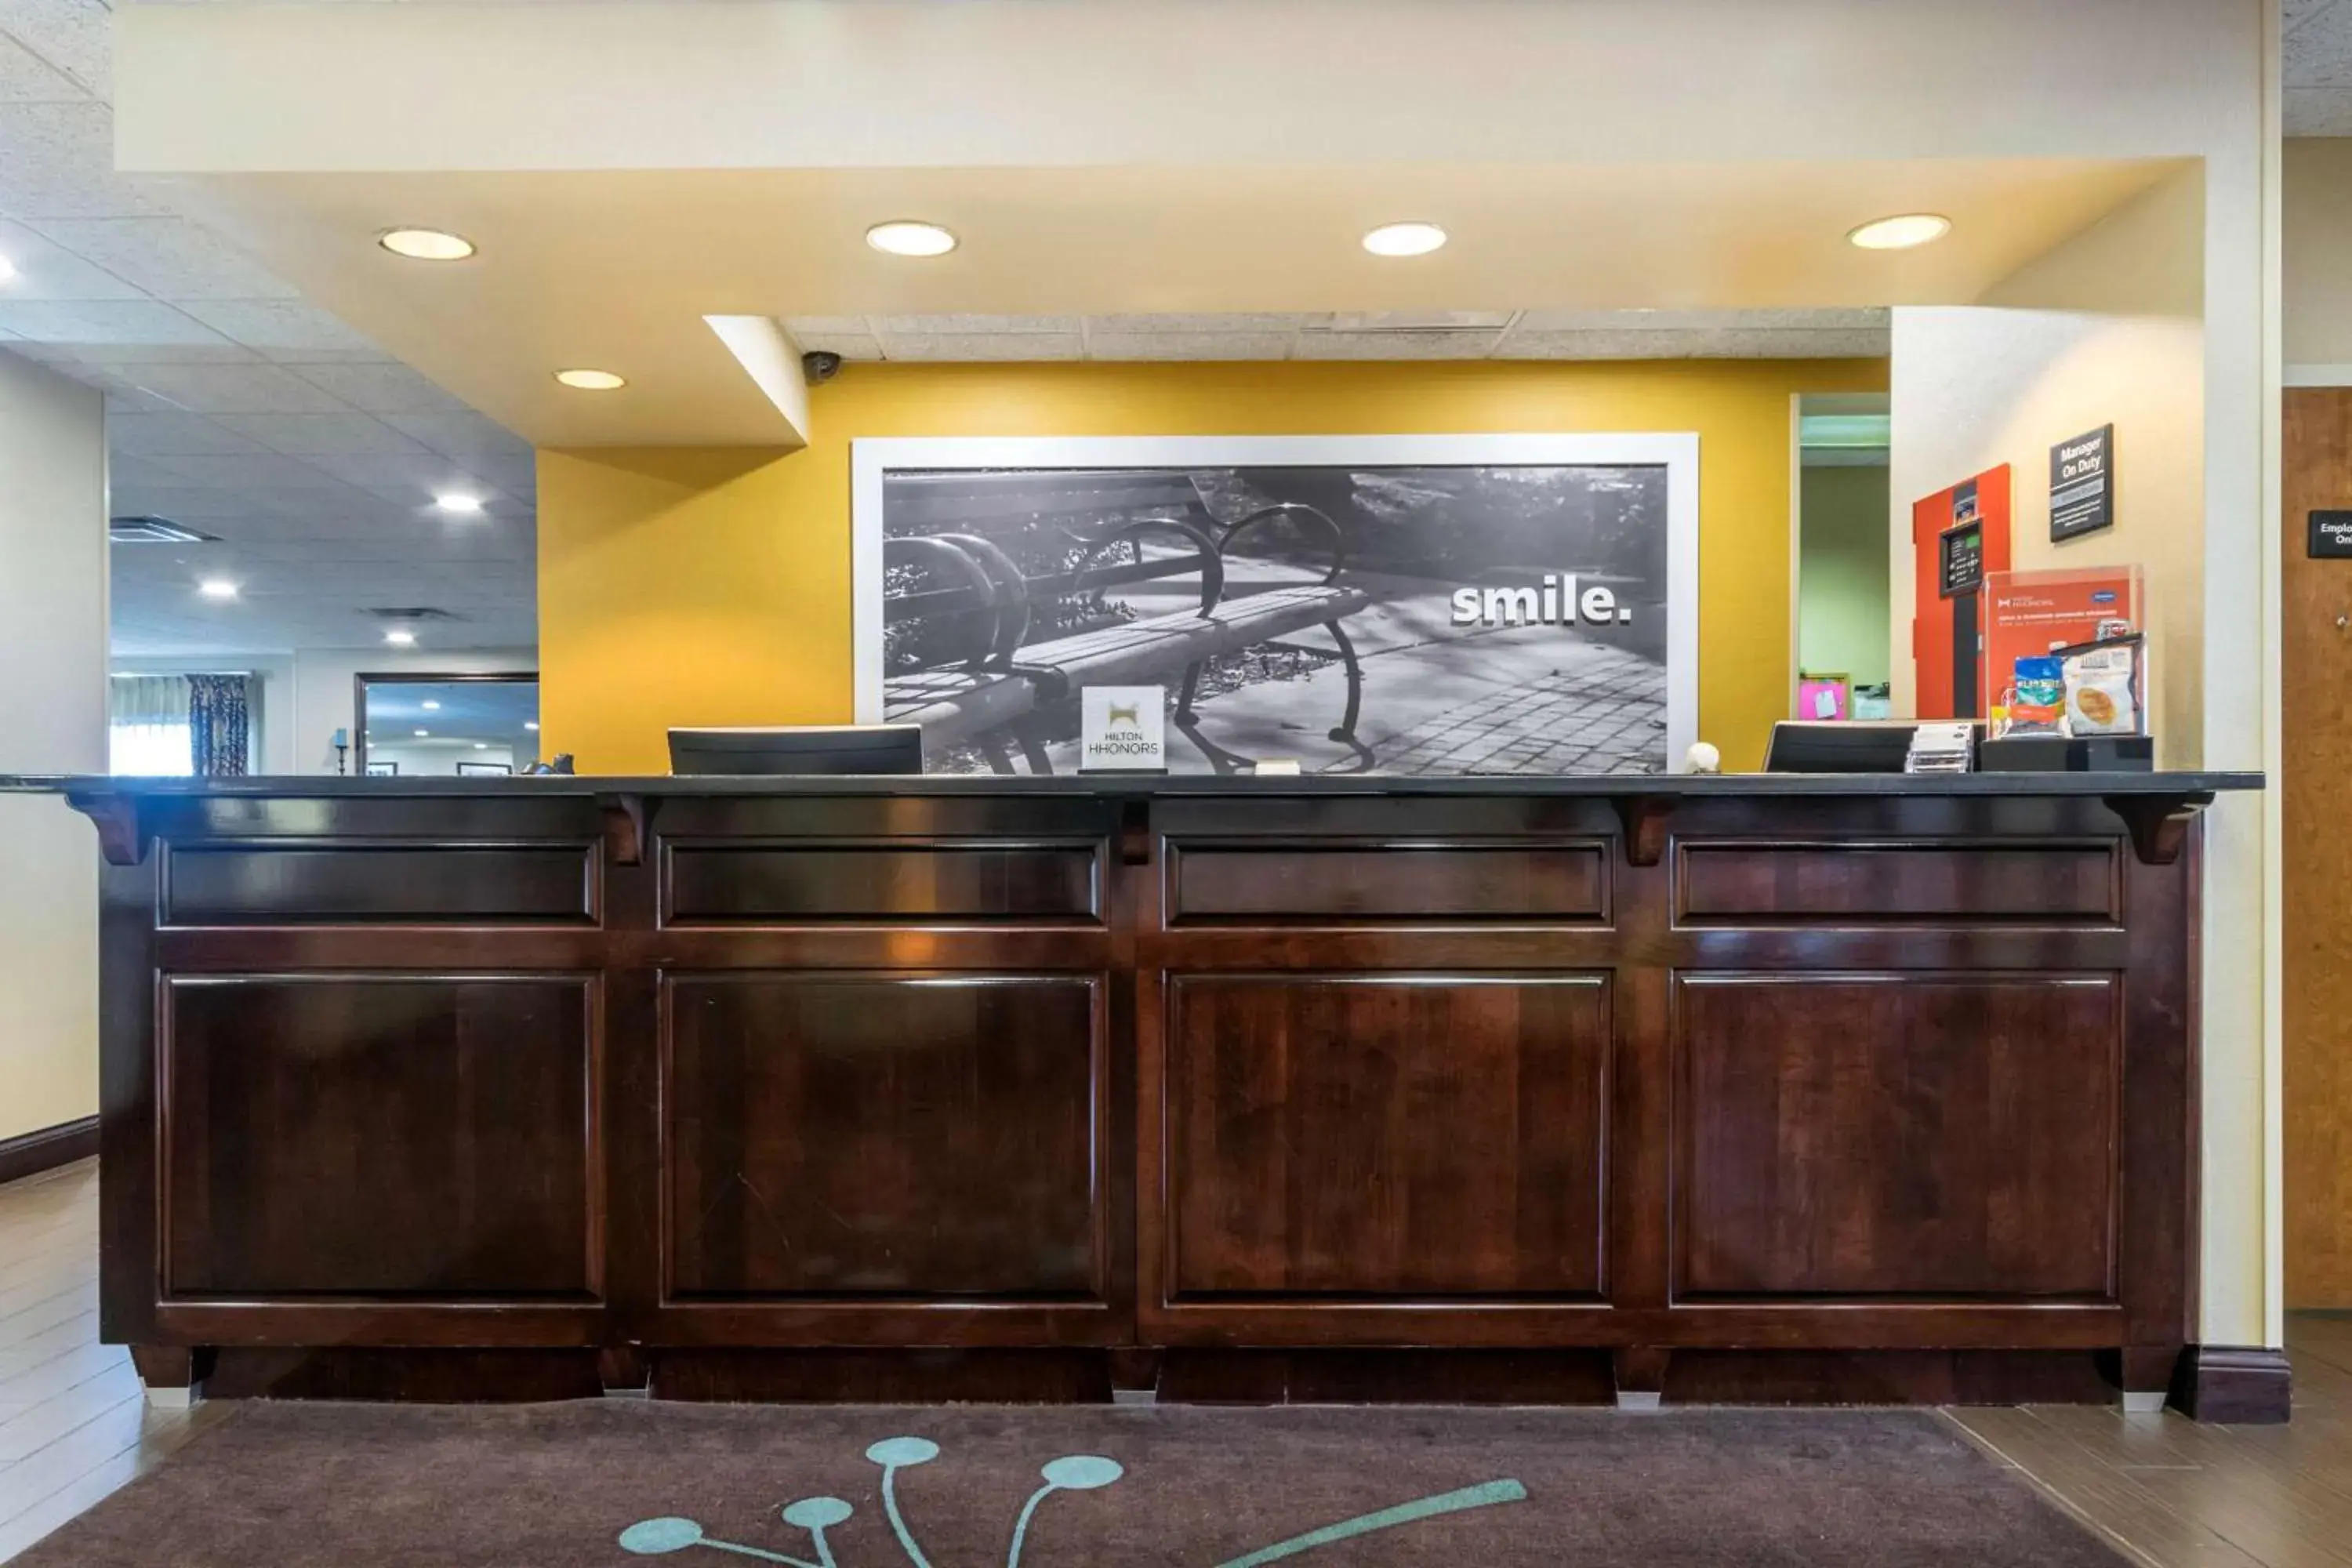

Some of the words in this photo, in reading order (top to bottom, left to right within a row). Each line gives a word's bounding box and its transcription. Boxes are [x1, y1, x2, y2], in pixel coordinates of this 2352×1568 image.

[2061, 437, 2101, 462] Manager
[2063, 465, 2077, 478] On
[2078, 456, 2101, 473] Duty
[1452, 574, 1632, 623] smile.
[1105, 731, 1143, 741] HILTON
[1089, 742, 1158, 754] HHONORS
